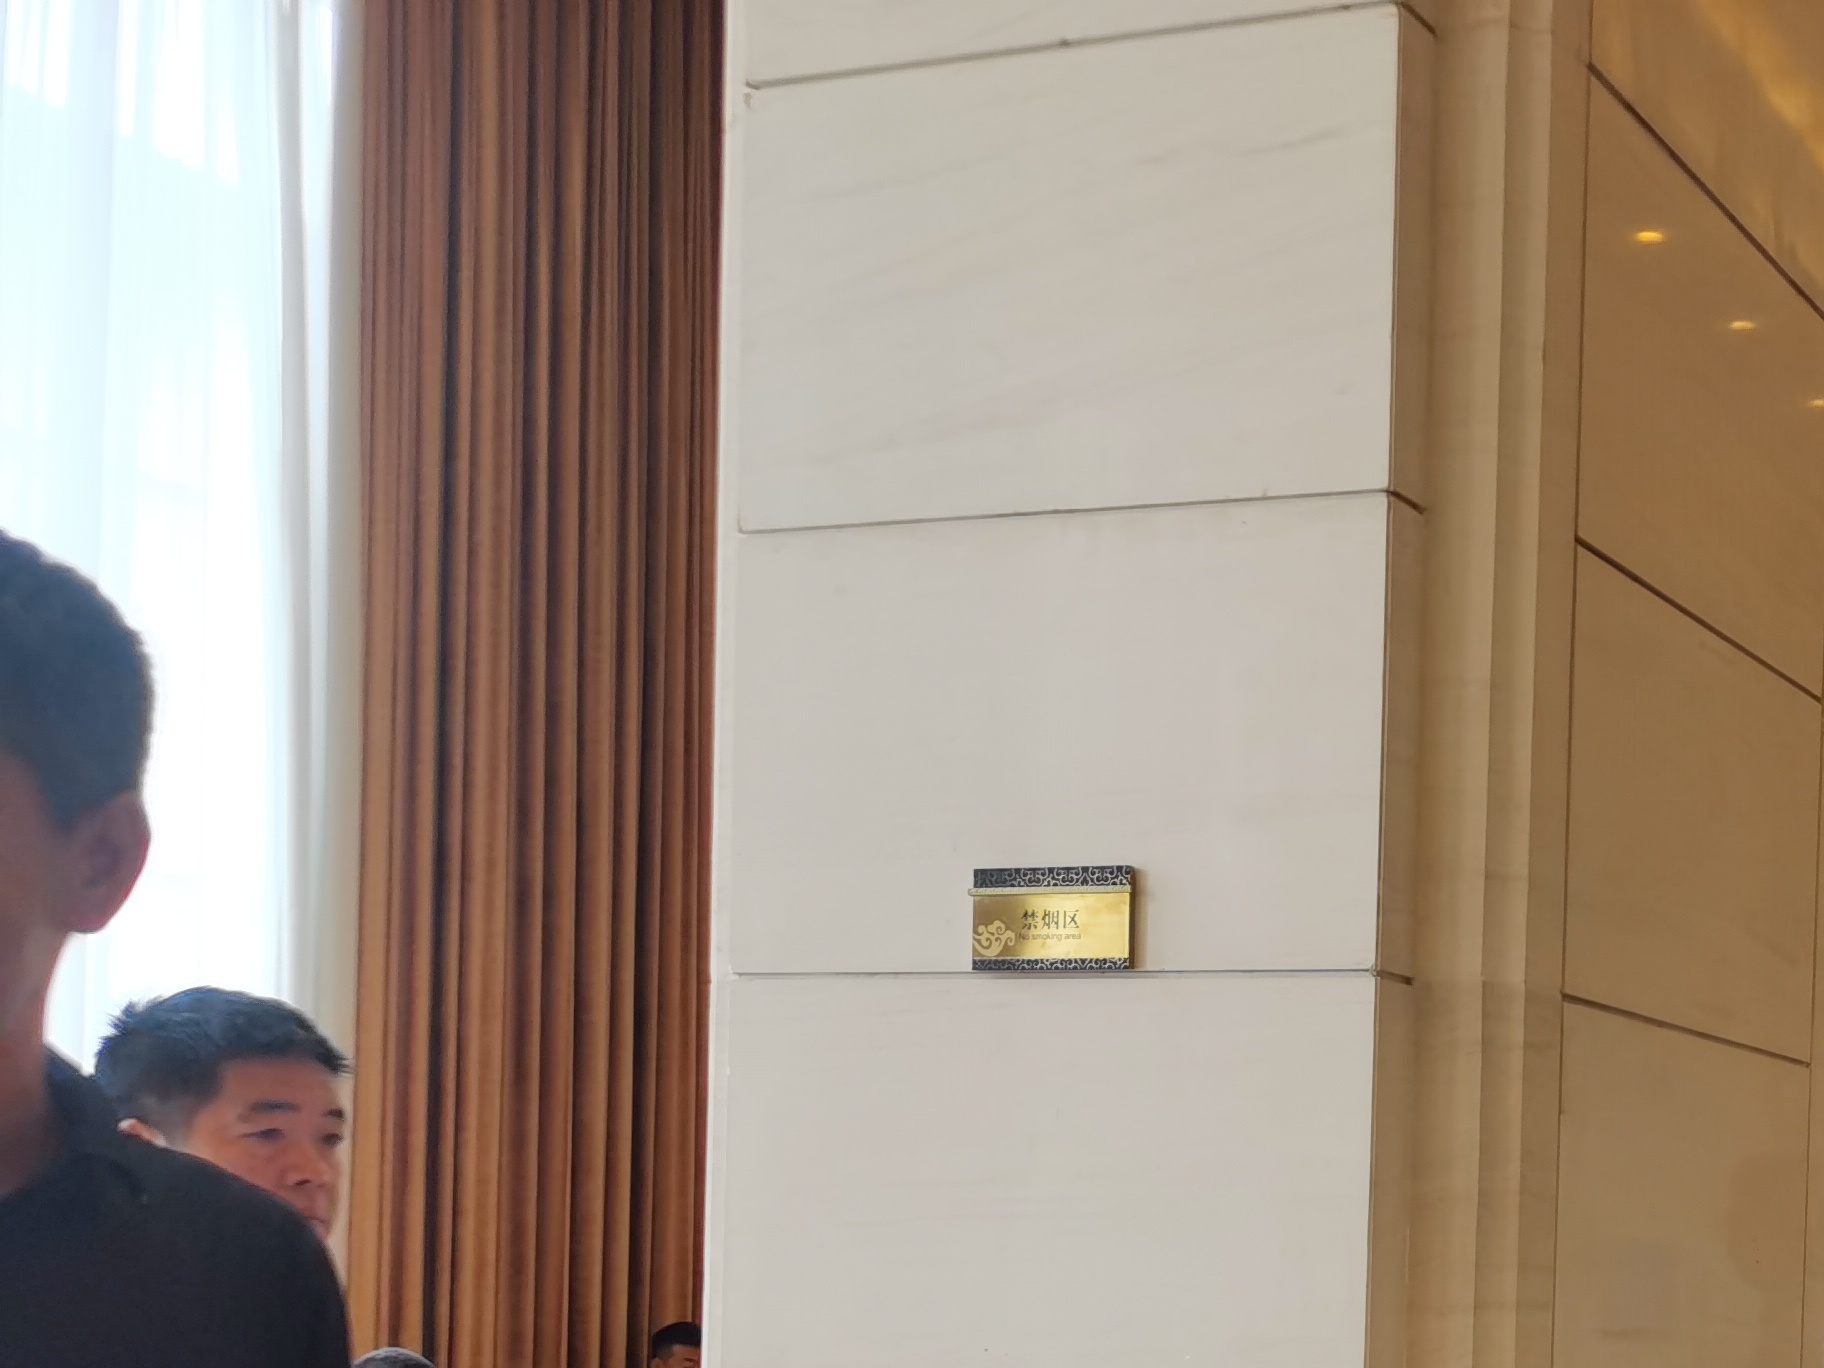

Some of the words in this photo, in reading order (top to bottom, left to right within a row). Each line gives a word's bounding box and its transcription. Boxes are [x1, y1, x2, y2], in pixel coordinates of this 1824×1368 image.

[1020, 908, 1080, 930] 禁烟区
[1018, 932, 1031, 941] No
[1032, 932, 1063, 942] smoking
[1064, 933, 1082, 941] area
